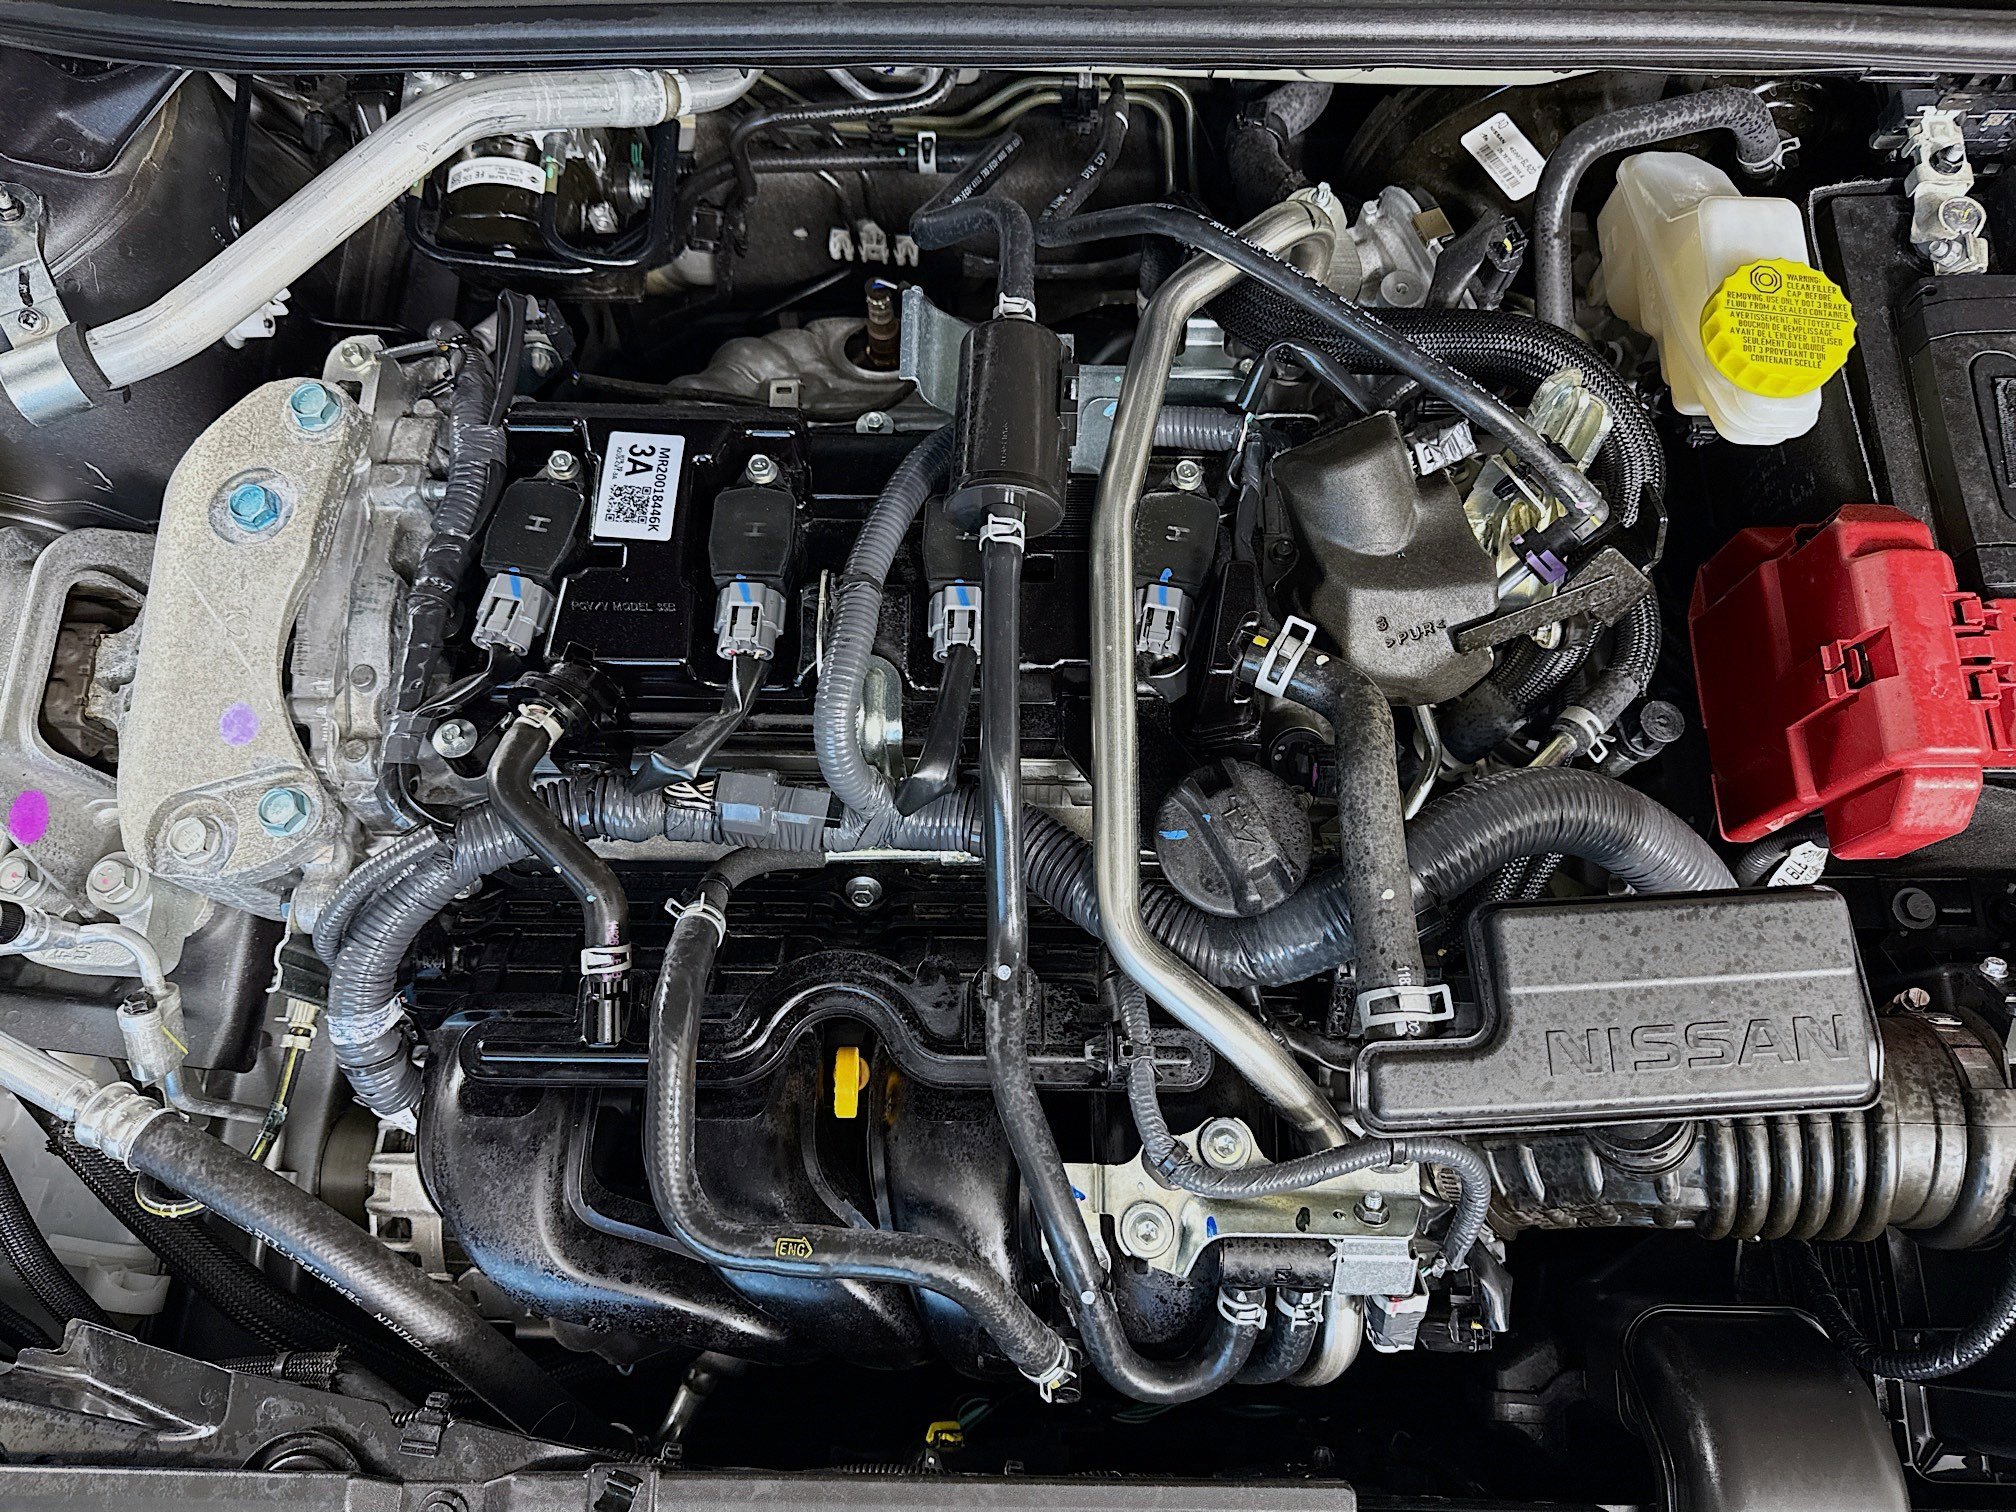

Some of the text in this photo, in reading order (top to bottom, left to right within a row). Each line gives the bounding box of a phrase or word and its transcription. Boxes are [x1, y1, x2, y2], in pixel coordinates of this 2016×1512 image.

[1787, 282, 1837, 294] CLEAN FILLER
[1787, 290, 1831, 302] CAP BEFORE
[1726, 300, 1747, 308] FLUID
[1750, 302, 1770, 311] FROM
[1772, 304, 1777, 312] A
[1779, 305, 1807, 315] SEALED
[1766, 294, 1779, 304] USE
[1781, 296, 1799, 306] ONLY
[1802, 299, 1815, 308] DOT
[1816, 301, 1822, 309] 3
[1823, 302, 1847, 312] BRAKE
[1738, 319, 1833, 337] BOUCHON DE REMPLISSAGE
[1793, 318, 1831, 329] NETTOYER
[1832, 321, 1841, 330] LE
[1730, 327, 1756, 337] AVANT
[1758, 329, 1766, 337] DE
[1811, 335, 1843, 346] UTILISER
[1743, 336, 1826, 352] SEULEMENT DU LIQUIDE
[1743, 344, 1756, 353] DOT
[1765, 347, 1807, 359] PROVENANT
[1750, 353, 1822, 369] CONTENANT SCELLÉ
[625, 444, 656, 476] 3A
[648, 447, 671, 532] MR20018446K
[612, 602, 653, 612] MODEL
[1545, 1013, 1850, 1077] NISSAN
[779, 1242, 805, 1257] ENG
